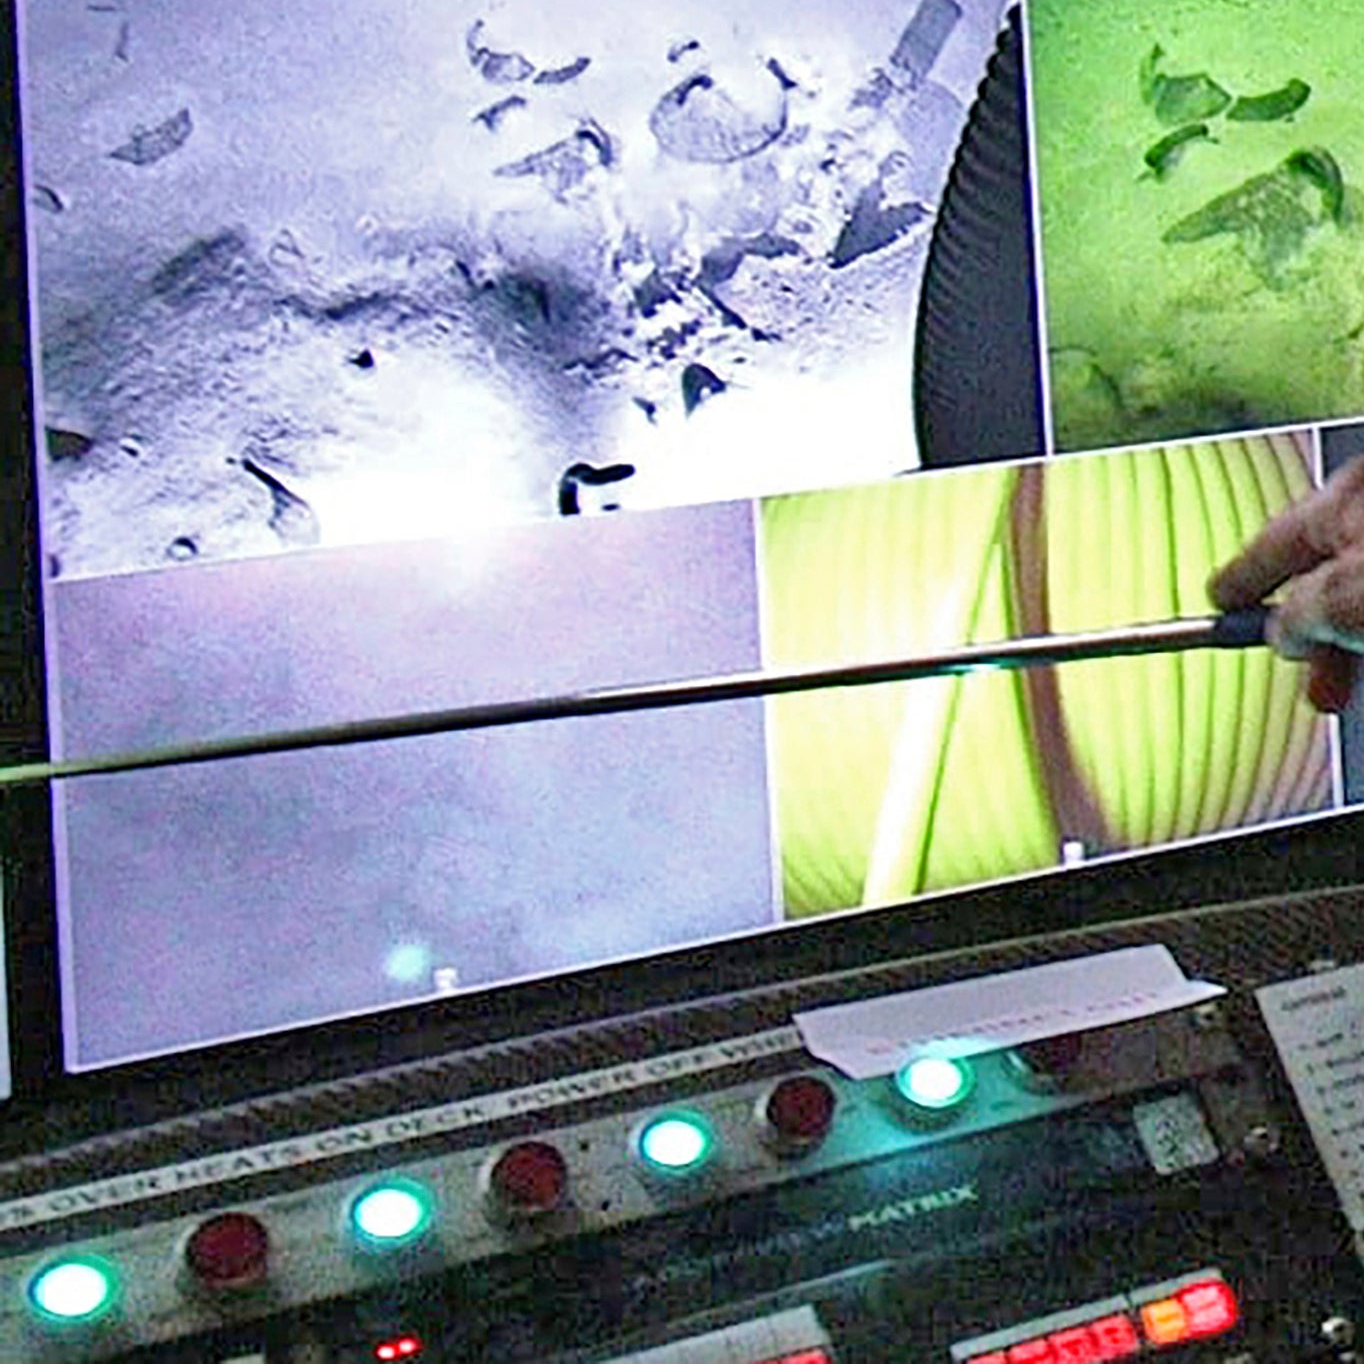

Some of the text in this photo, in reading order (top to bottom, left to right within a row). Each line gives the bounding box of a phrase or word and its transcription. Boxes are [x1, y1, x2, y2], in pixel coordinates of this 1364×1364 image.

[50, 1177, 159, 1209] OVER
[316, 1128, 372, 1153] ON
[387, 1105, 485, 1137] DECK
